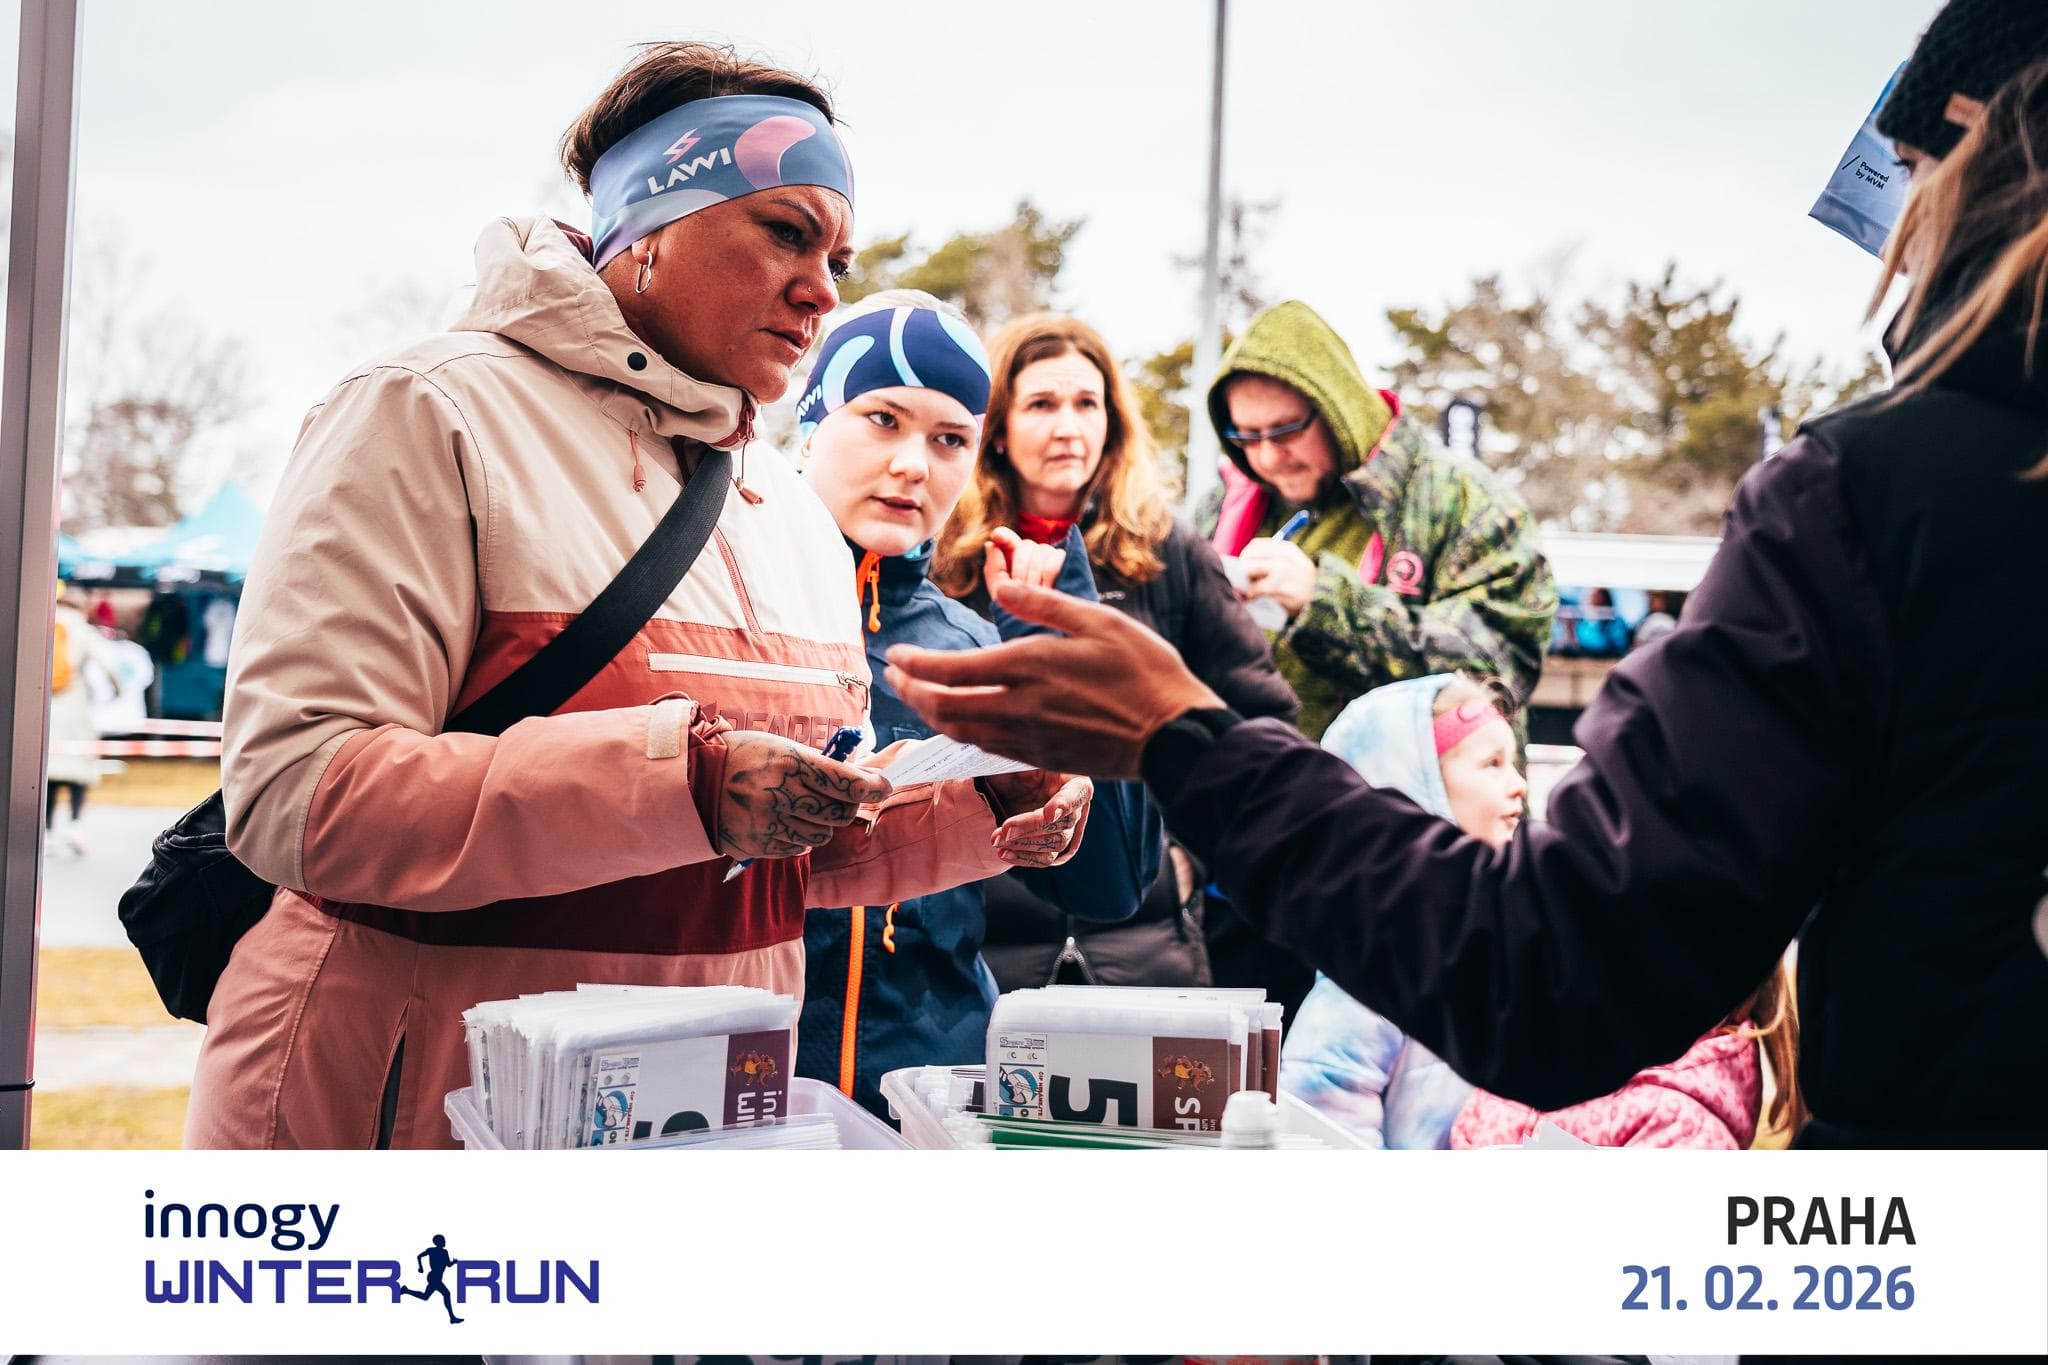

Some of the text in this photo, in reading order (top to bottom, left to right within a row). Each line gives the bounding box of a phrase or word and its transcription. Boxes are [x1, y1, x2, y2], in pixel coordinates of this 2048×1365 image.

[1855, 169, 1885, 190] by MVM
[1860, 161, 1890, 183] Powered
